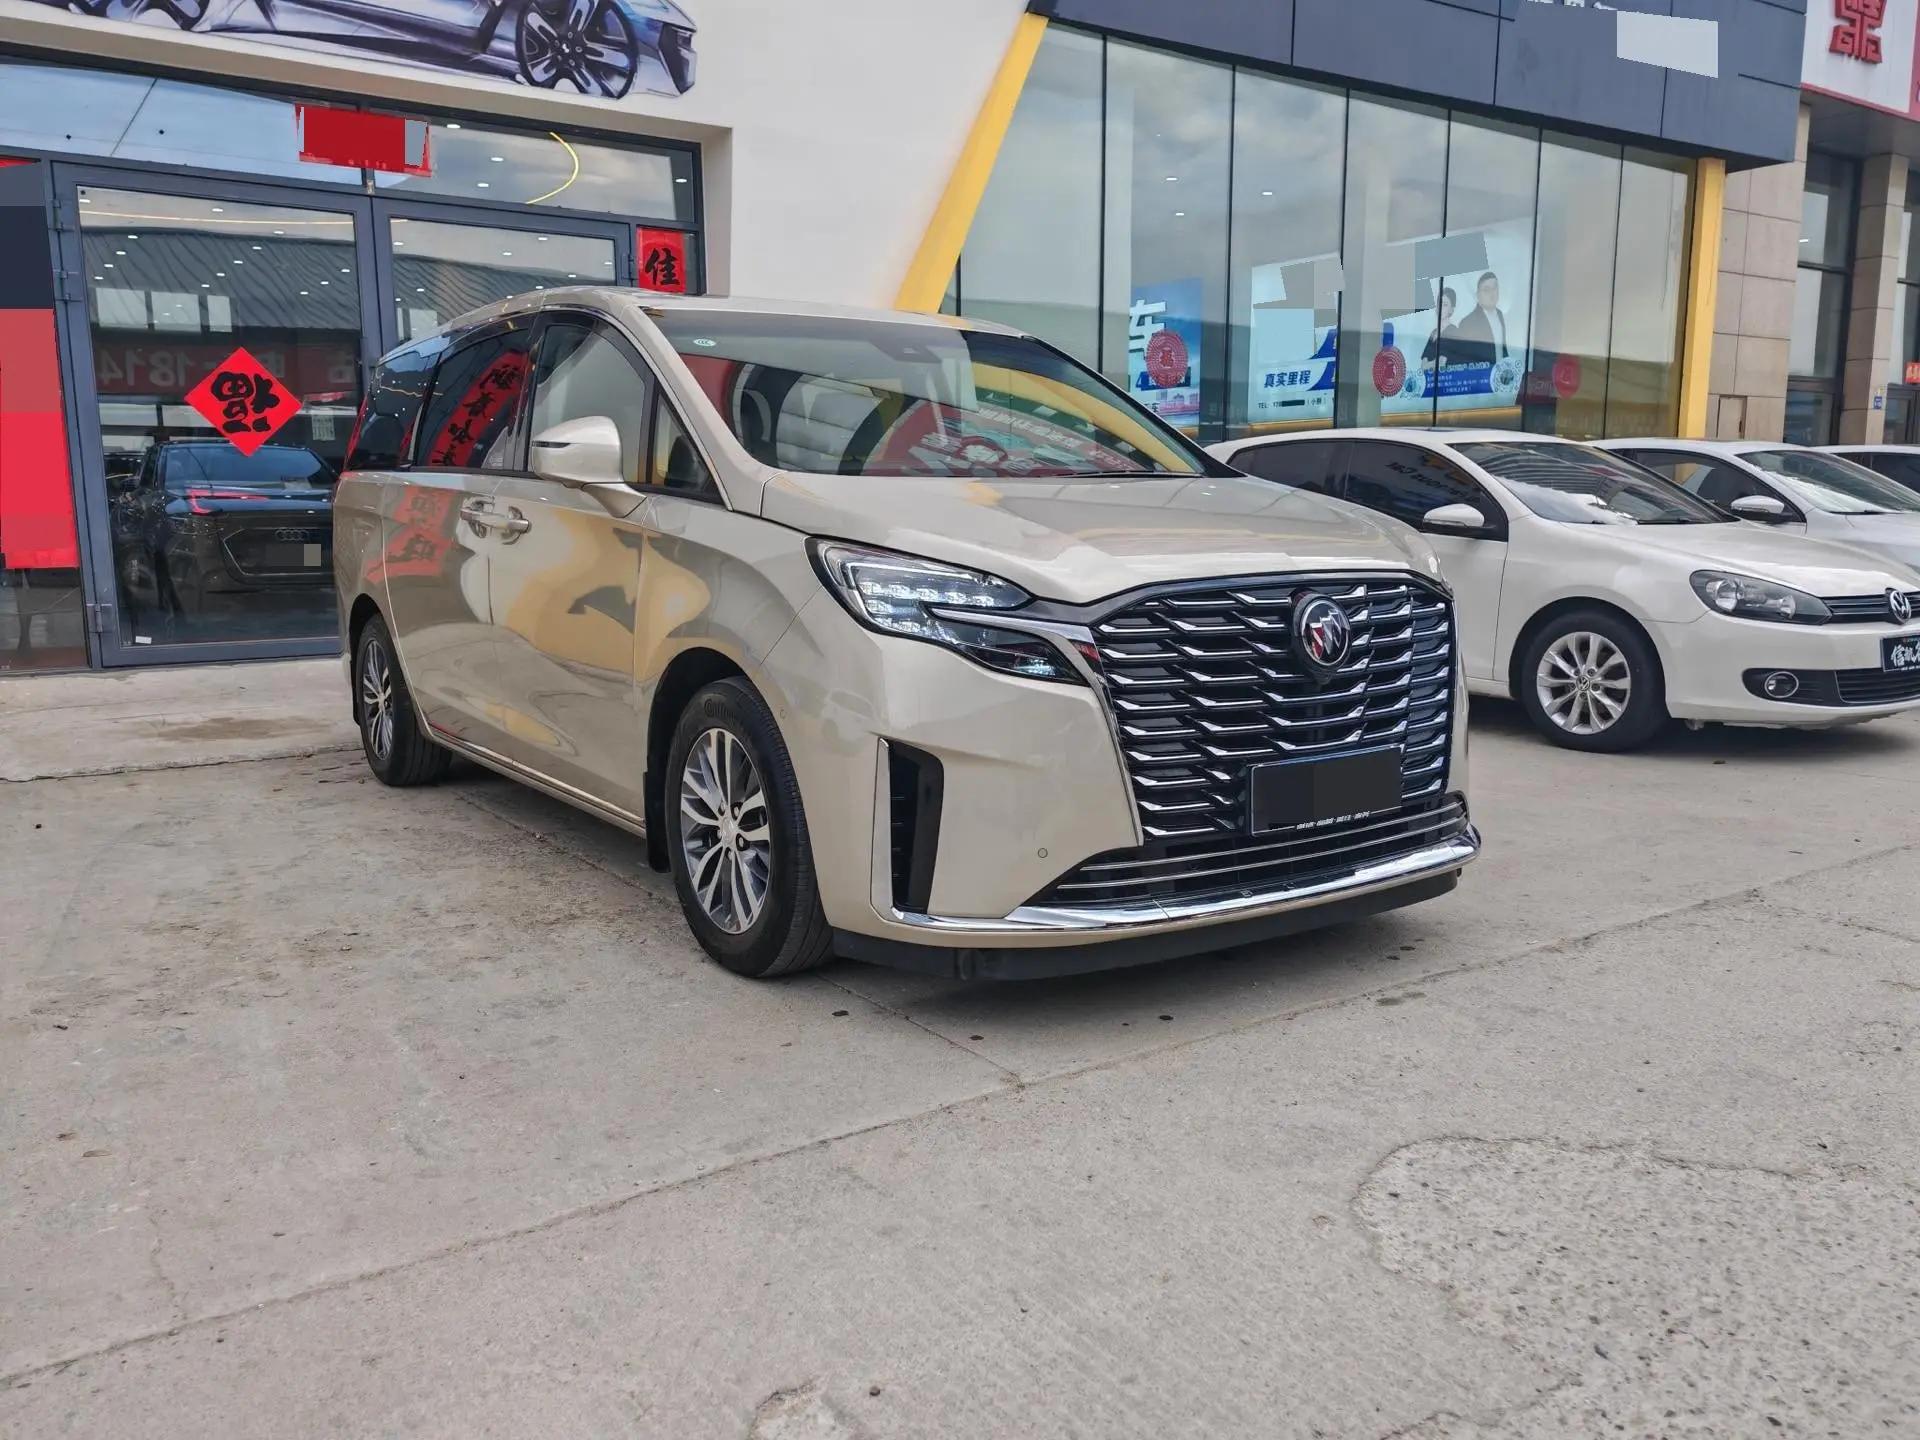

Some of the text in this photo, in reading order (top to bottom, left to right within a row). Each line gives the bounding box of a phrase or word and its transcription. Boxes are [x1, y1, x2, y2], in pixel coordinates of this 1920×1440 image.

[645, 248, 681, 286] 佳
[1263, 370, 1311, 388] 真实里程
[210, 371, 281, 433] 福
